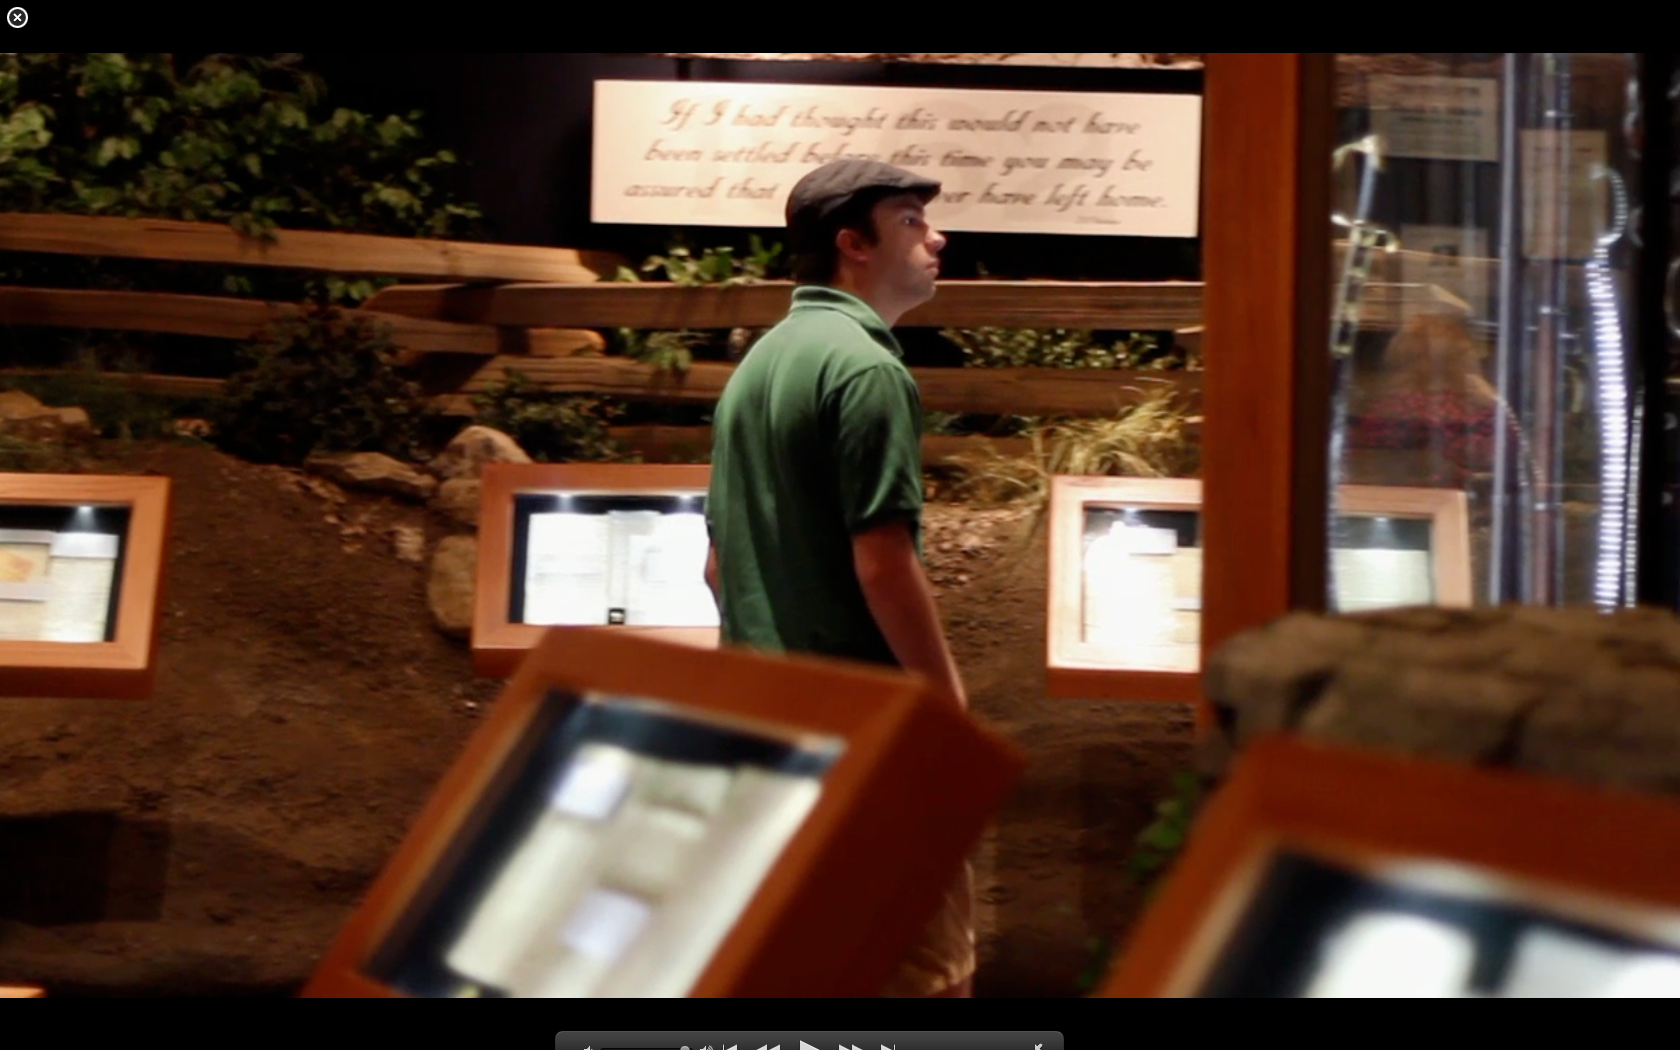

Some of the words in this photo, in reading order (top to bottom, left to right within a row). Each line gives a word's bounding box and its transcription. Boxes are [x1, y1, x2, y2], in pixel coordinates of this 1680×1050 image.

[661, 99, 702, 131] If
[703, 98, 731, 125] I
[732, 105, 788, 127] had
[790, 106, 888, 136] thought
[895, 108, 938, 131] this
[946, 110, 1032, 132] would
[1033, 113, 1077, 133] not
[1082, 112, 1142, 134] have
[644, 139, 700, 161] been
[712, 141, 800, 163] settled
[888, 144, 934, 167] this
[939, 150, 995, 168] time
[1002, 156, 1050, 176] you
[1056, 157, 1116, 178] may
[1121, 149, 1154, 171] be
[624, 176, 725, 199] assured
[727, 177, 780, 199] that
[978, 183, 1037, 206] have
[1044, 183, 1091, 212] left
